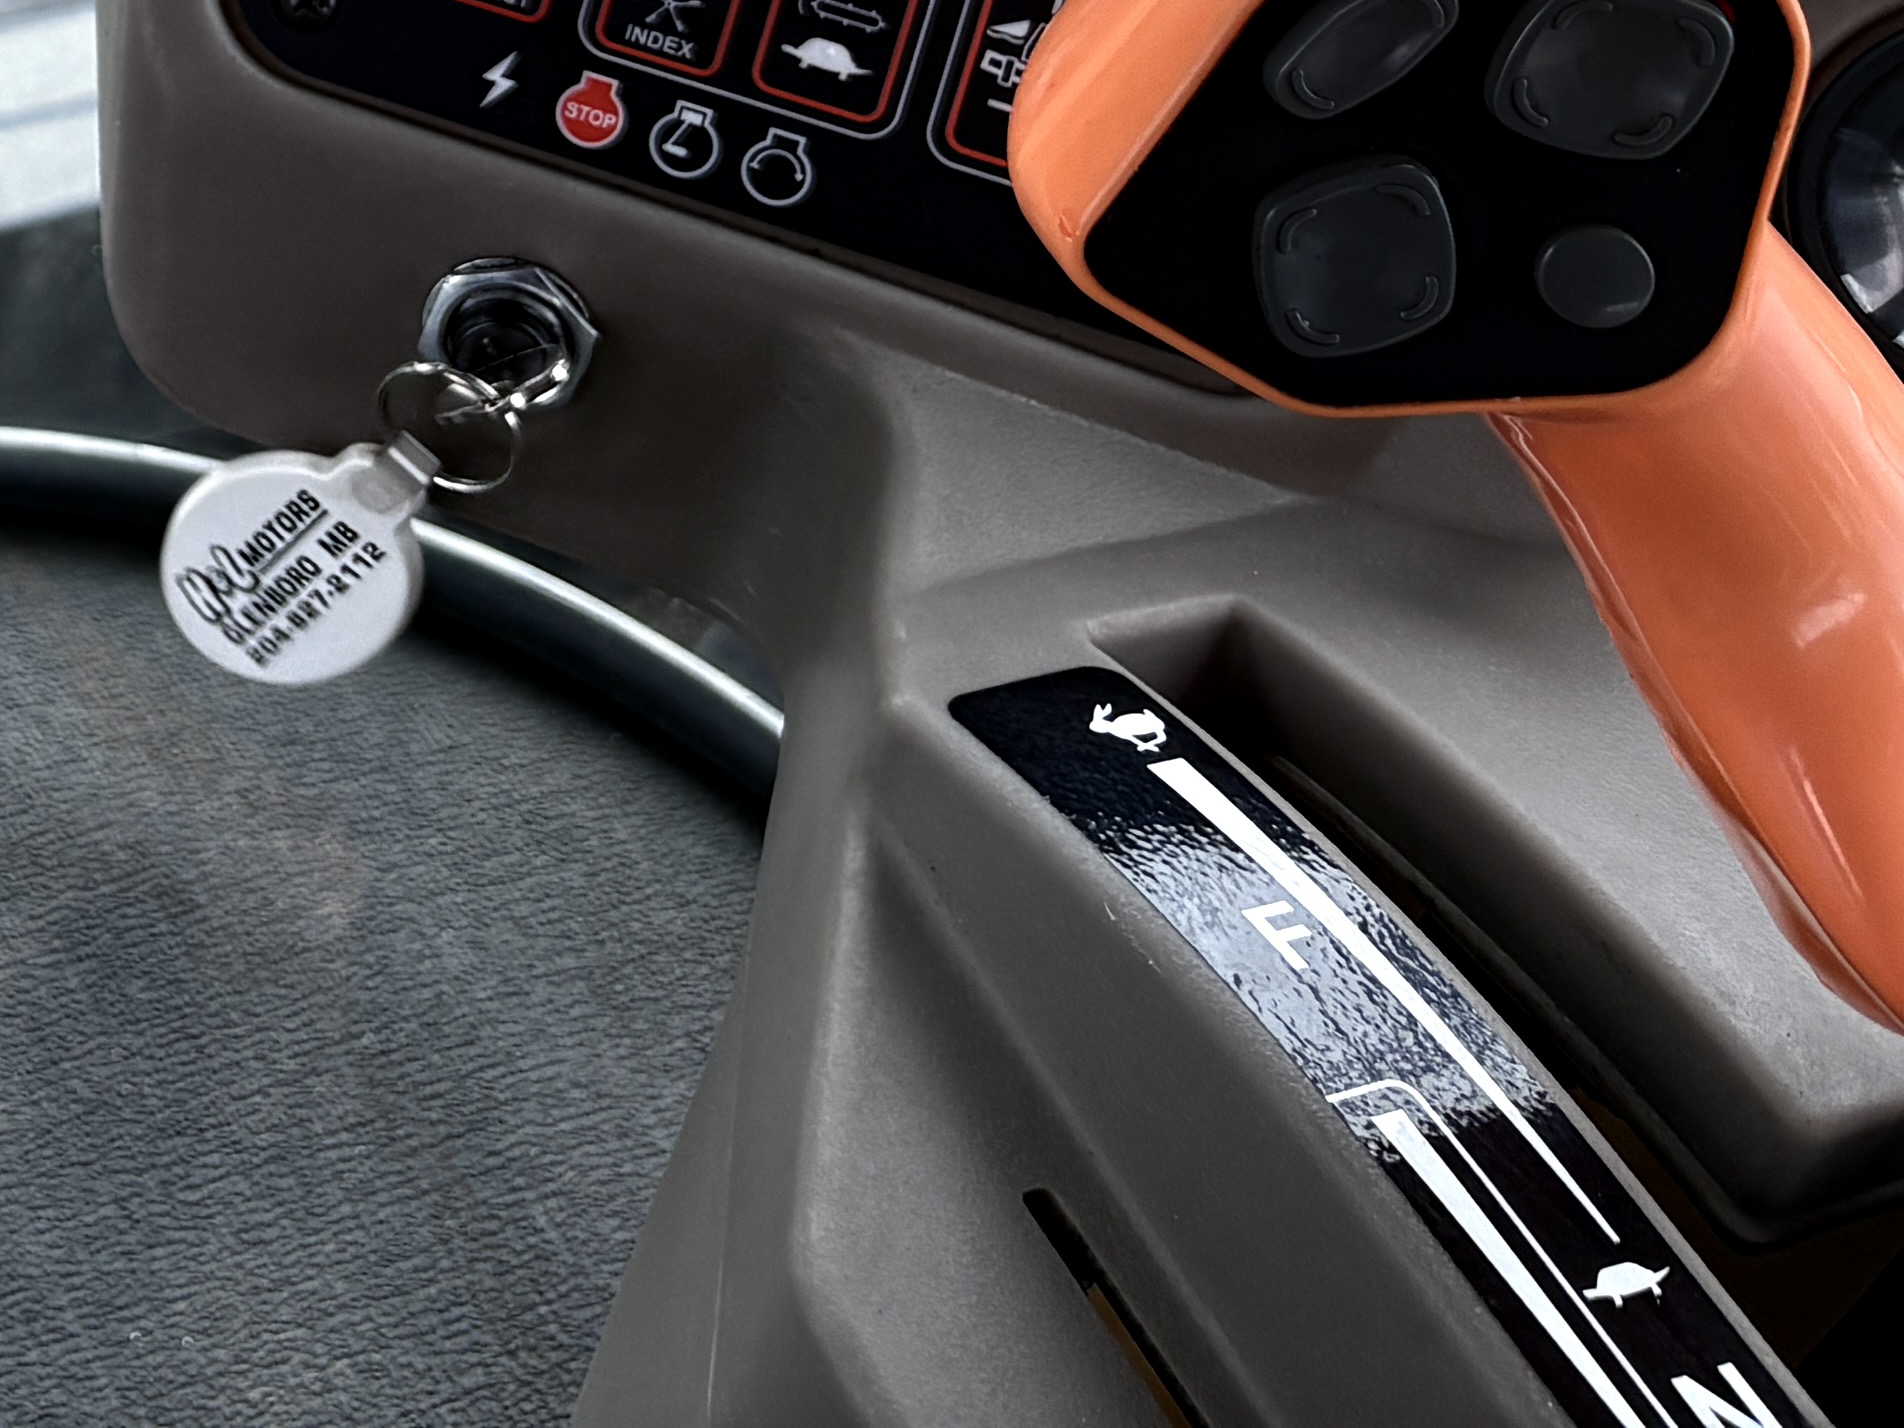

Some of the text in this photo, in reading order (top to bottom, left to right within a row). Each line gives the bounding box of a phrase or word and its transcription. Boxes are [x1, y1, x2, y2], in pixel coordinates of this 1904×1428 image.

[624, 23, 695, 60] INDEX
[563, 100, 617, 129] STOP
[235, 488, 321, 567] MOTORS
[316, 520, 361, 559] MB
[1240, 899, 1313, 971] F
